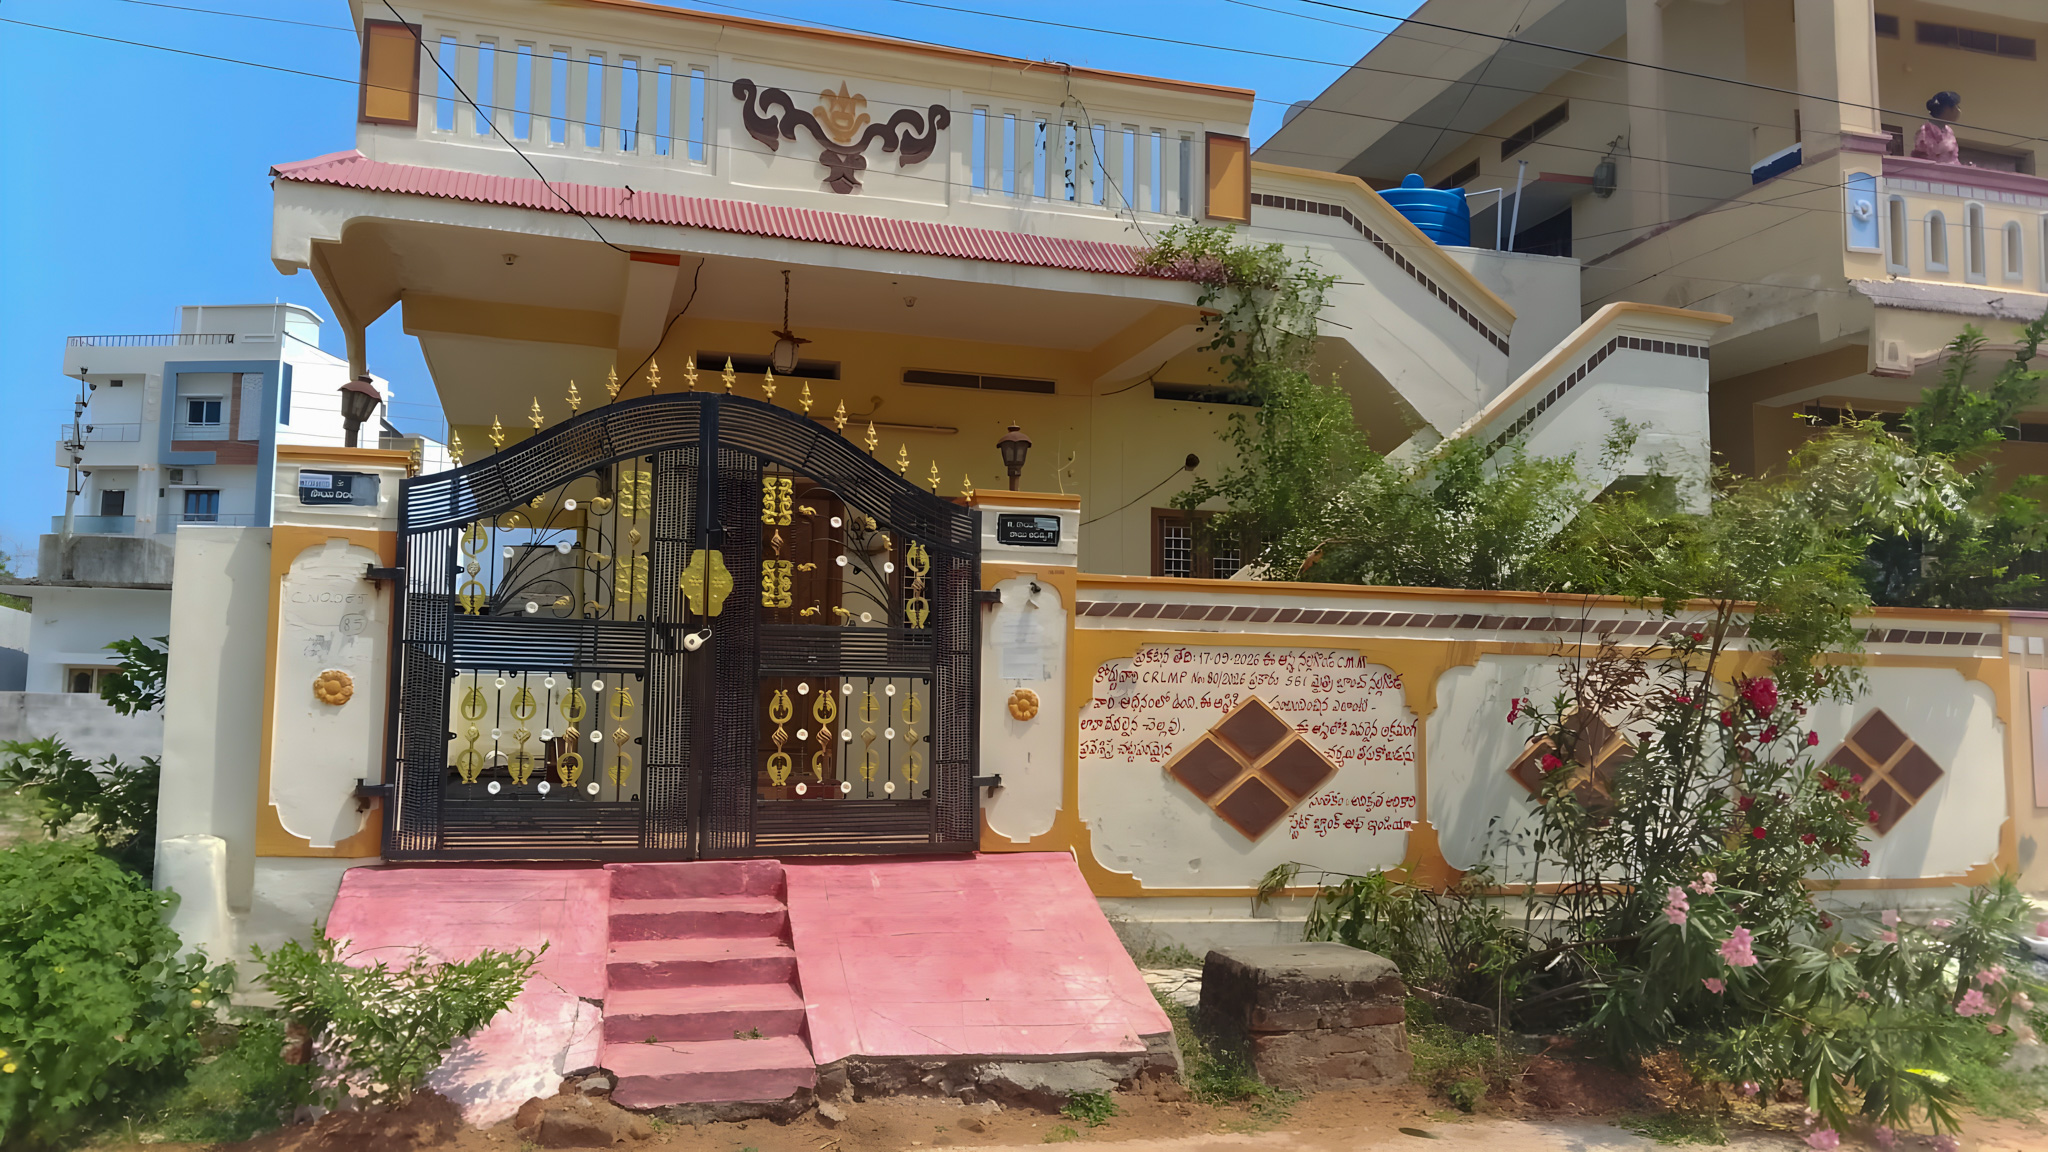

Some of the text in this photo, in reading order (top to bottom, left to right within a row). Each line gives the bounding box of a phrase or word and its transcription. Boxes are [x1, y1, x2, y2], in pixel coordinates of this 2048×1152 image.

[1199, 652, 1260, 665] 17-09-2026
[1263, 652, 1276, 666] ఈ
[1337, 655, 1368, 668] CMM
[1142, 670, 1188, 684] CRLMP
[1093, 698, 1115, 709] వారి
